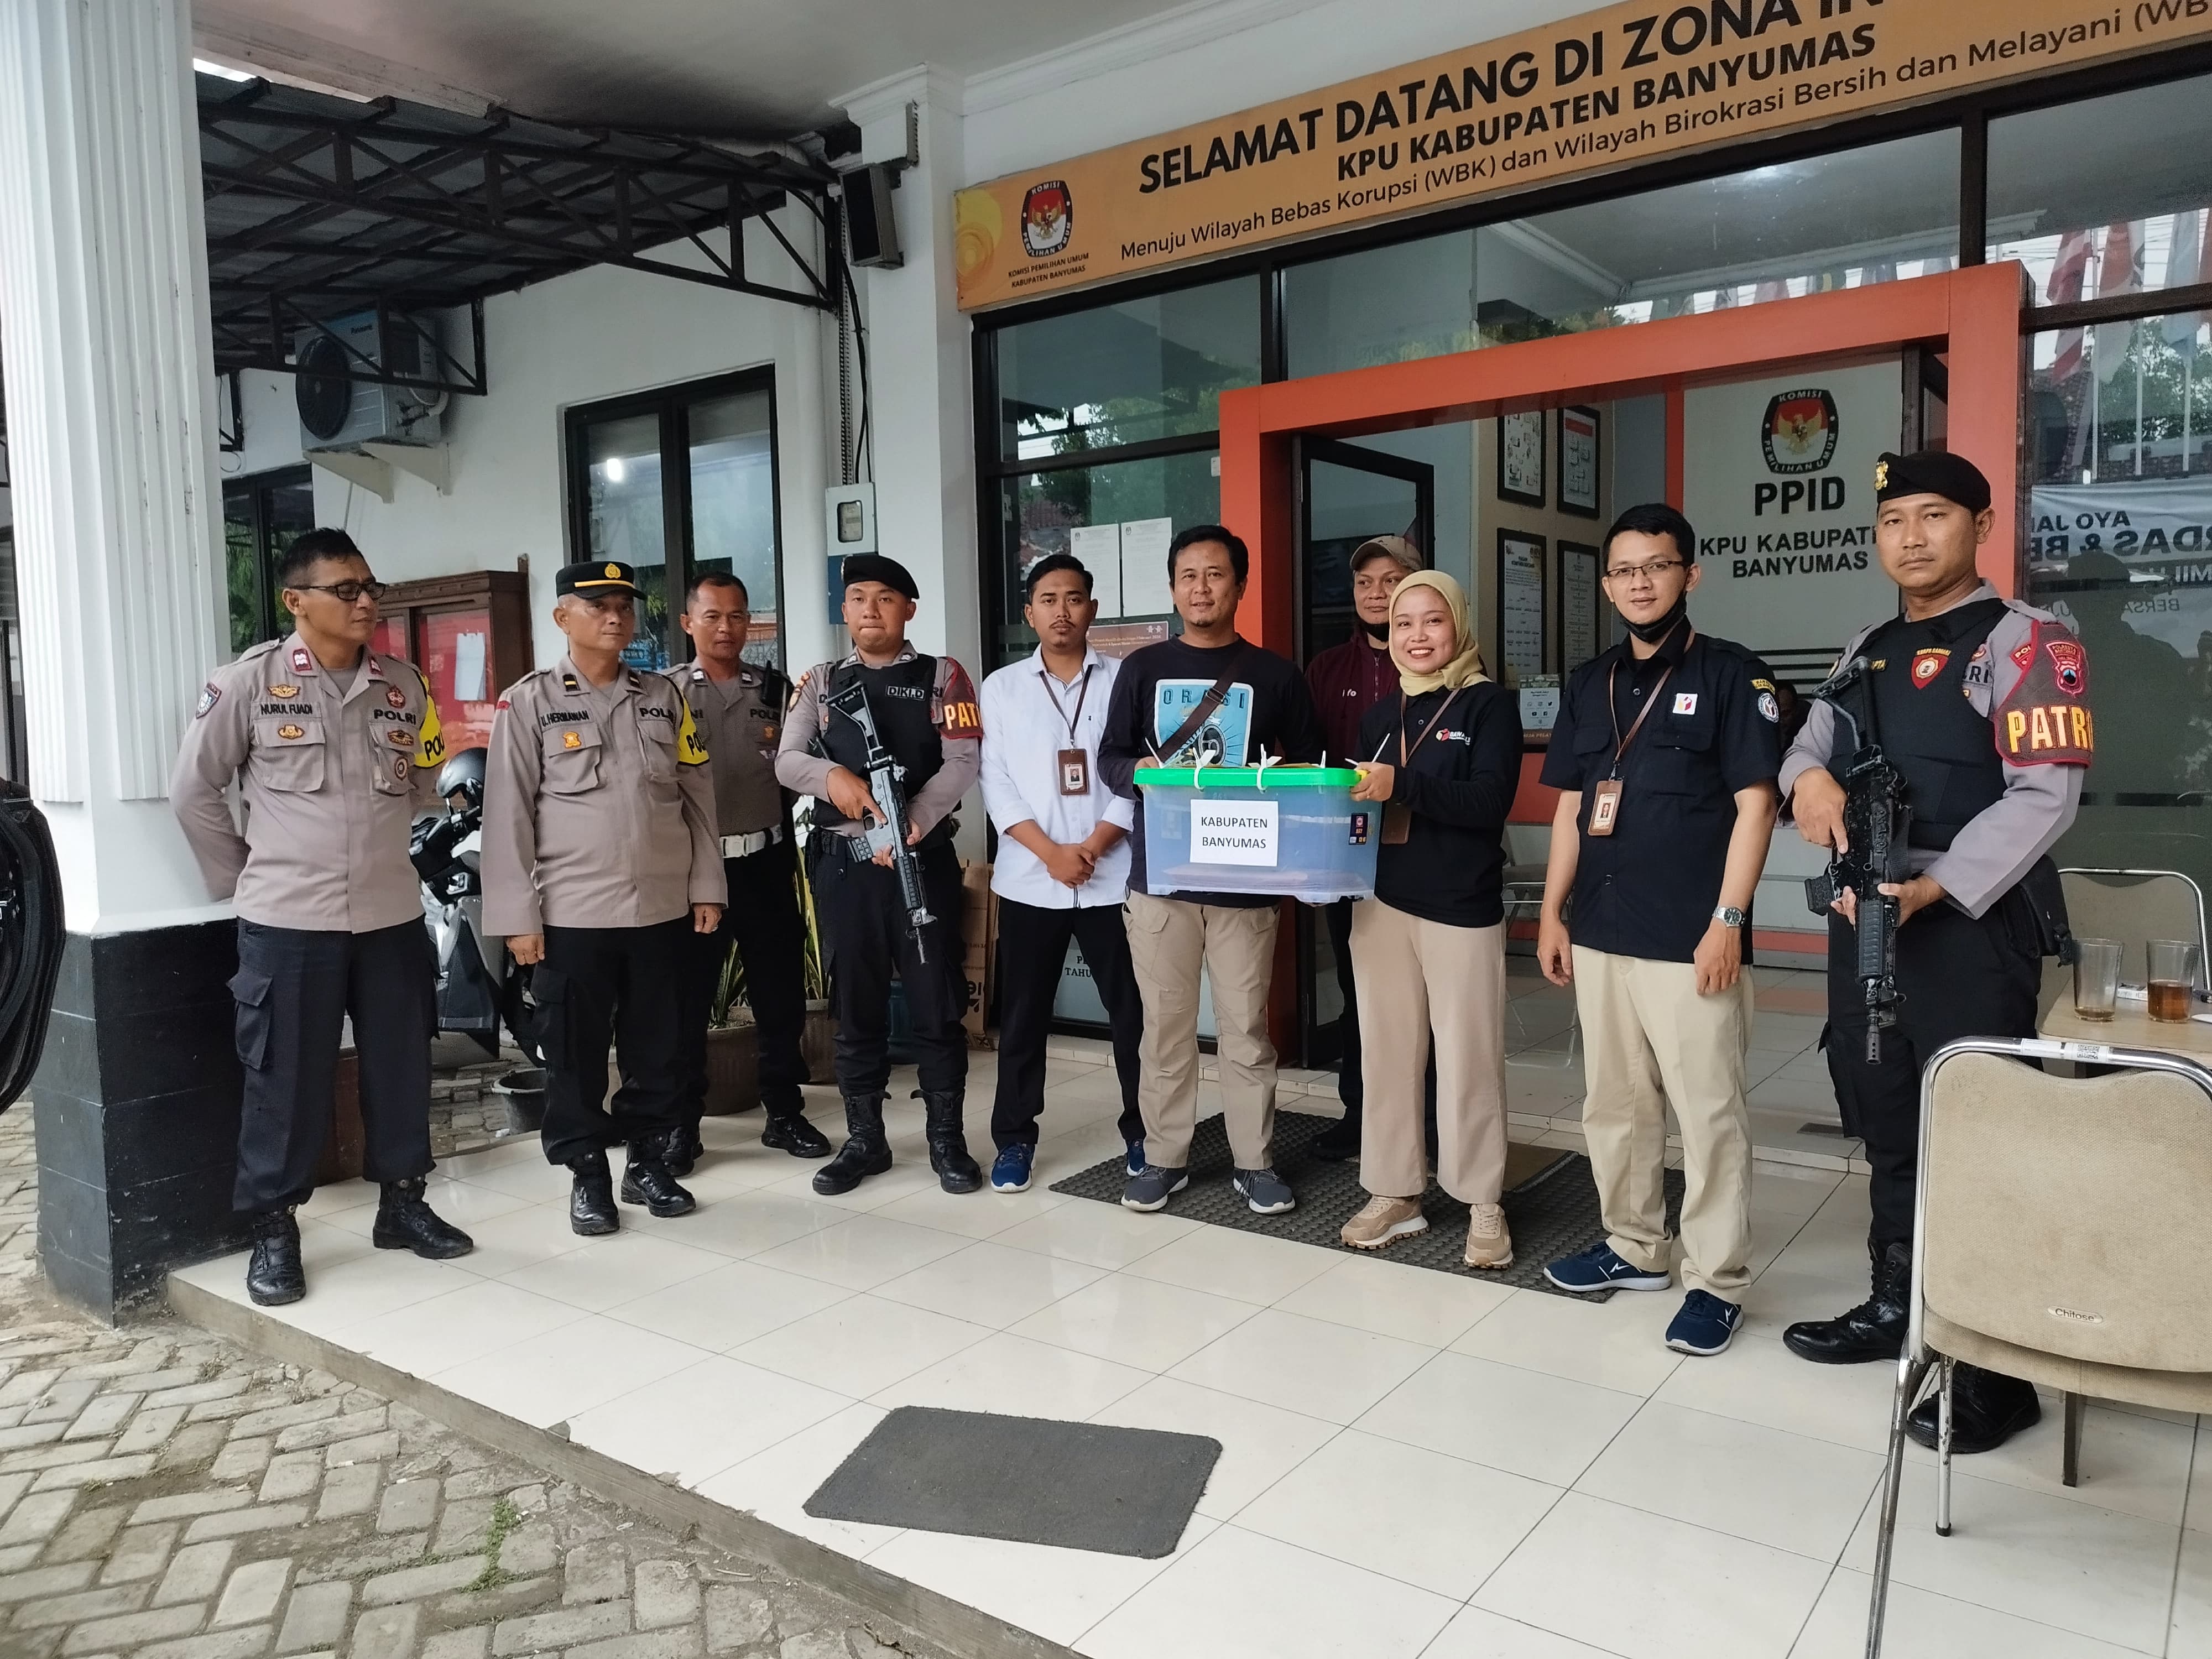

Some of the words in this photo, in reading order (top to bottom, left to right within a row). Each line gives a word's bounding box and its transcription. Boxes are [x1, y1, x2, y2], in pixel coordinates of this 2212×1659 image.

[1139, 108, 1323, 194] SELAMAT
[1336, 51, 1539, 143] DATANG
[1555, 31, 1603, 87] DI
[1621, 0, 1802, 70] ZONA
[1338, 142, 1399, 181] KPU
[1410, 86, 1619, 163] KABUPATEN
[1634, 23, 1875, 109] BANYUMAS
[1121, 232, 1186, 260] Menuju
[1191, 212, 1265, 244] Wilayah
[1272, 199, 1331, 225] Bebas
[1337, 173, 1417, 210] Korupsi
[1425, 155, 1496, 191] (WBK)
[1501, 148, 1547, 172] dan
[1554, 119, 1656, 160] Wilayah
[1665, 87, 1783, 135] Birokrasi
[1794, 67, 1886, 106] Bersih
[1896, 54, 1957, 82] dan
[1969, 8, 2120, 67] Melayani
[1032, 181, 1060, 195] KOMISI
[1008, 268, 1030, 278] KOMISI
[1031, 258, 1066, 273] PEMILIHAN
[1067, 253, 1089, 263] UMUM
[1011, 273, 1048, 288] KABUPATEN
[1050, 265, 1086, 276] BANYUMAS
[1779, 390, 1822, 402] KOMISI
[1763, 440, 1812, 471] PEMILIHAN
[1755, 476, 1845, 517] PPID
[1700, 535, 1747, 556] KPU
[1757, 526, 1876, 553] KABUPAT
[1732, 551, 1869, 578] BANYUMAS
[260, 703, 289, 715] NURUL
[289, 703, 313, 714] FUADI
[1163, 688, 1246, 709] ORSI
[373, 708, 416, 725] POLRI
[943, 701, 982, 730] PAT
[1201, 816, 1268, 828] KABUPATEN
[1202, 837, 1267, 849] BANYUMAS
[2055, 1308, 2095, 1322] Chitose
